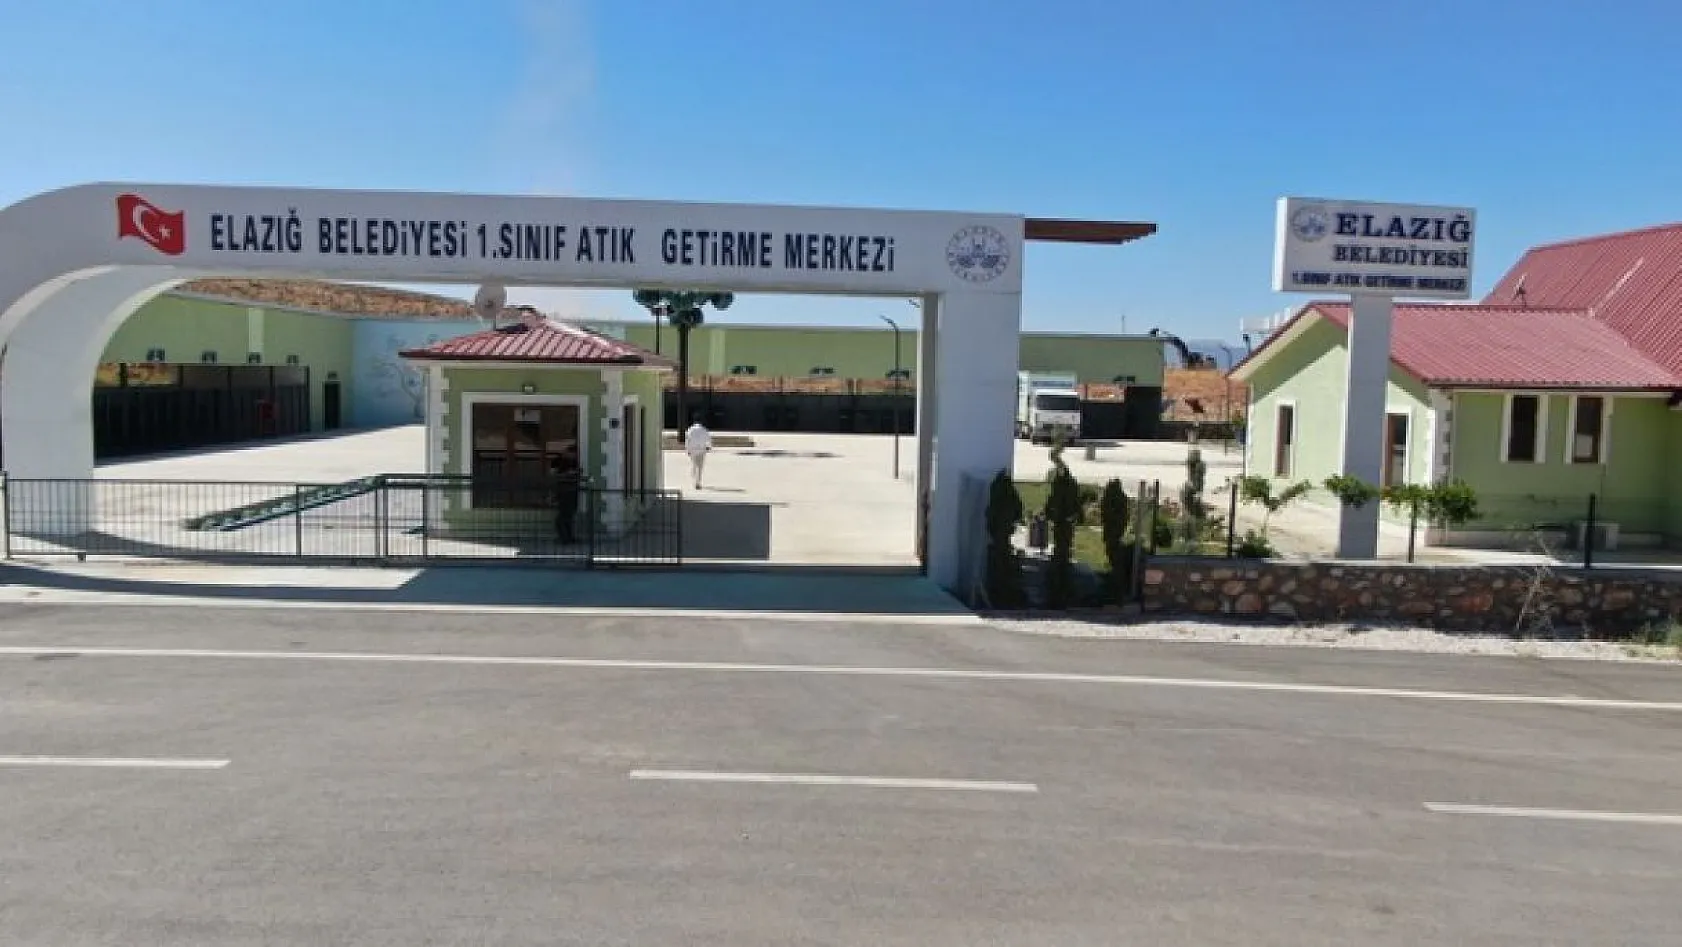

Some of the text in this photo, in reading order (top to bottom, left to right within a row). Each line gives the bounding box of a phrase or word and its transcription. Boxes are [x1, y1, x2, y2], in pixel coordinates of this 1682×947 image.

[211, 207, 302, 253] ELAZIĞ
[477, 223, 567, 262] 1.SINIF
[575, 226, 635, 263] ATIK
[1334, 212, 1473, 242] ELAZIĞ
[1334, 244, 1469, 268] BELEDİYESİ
